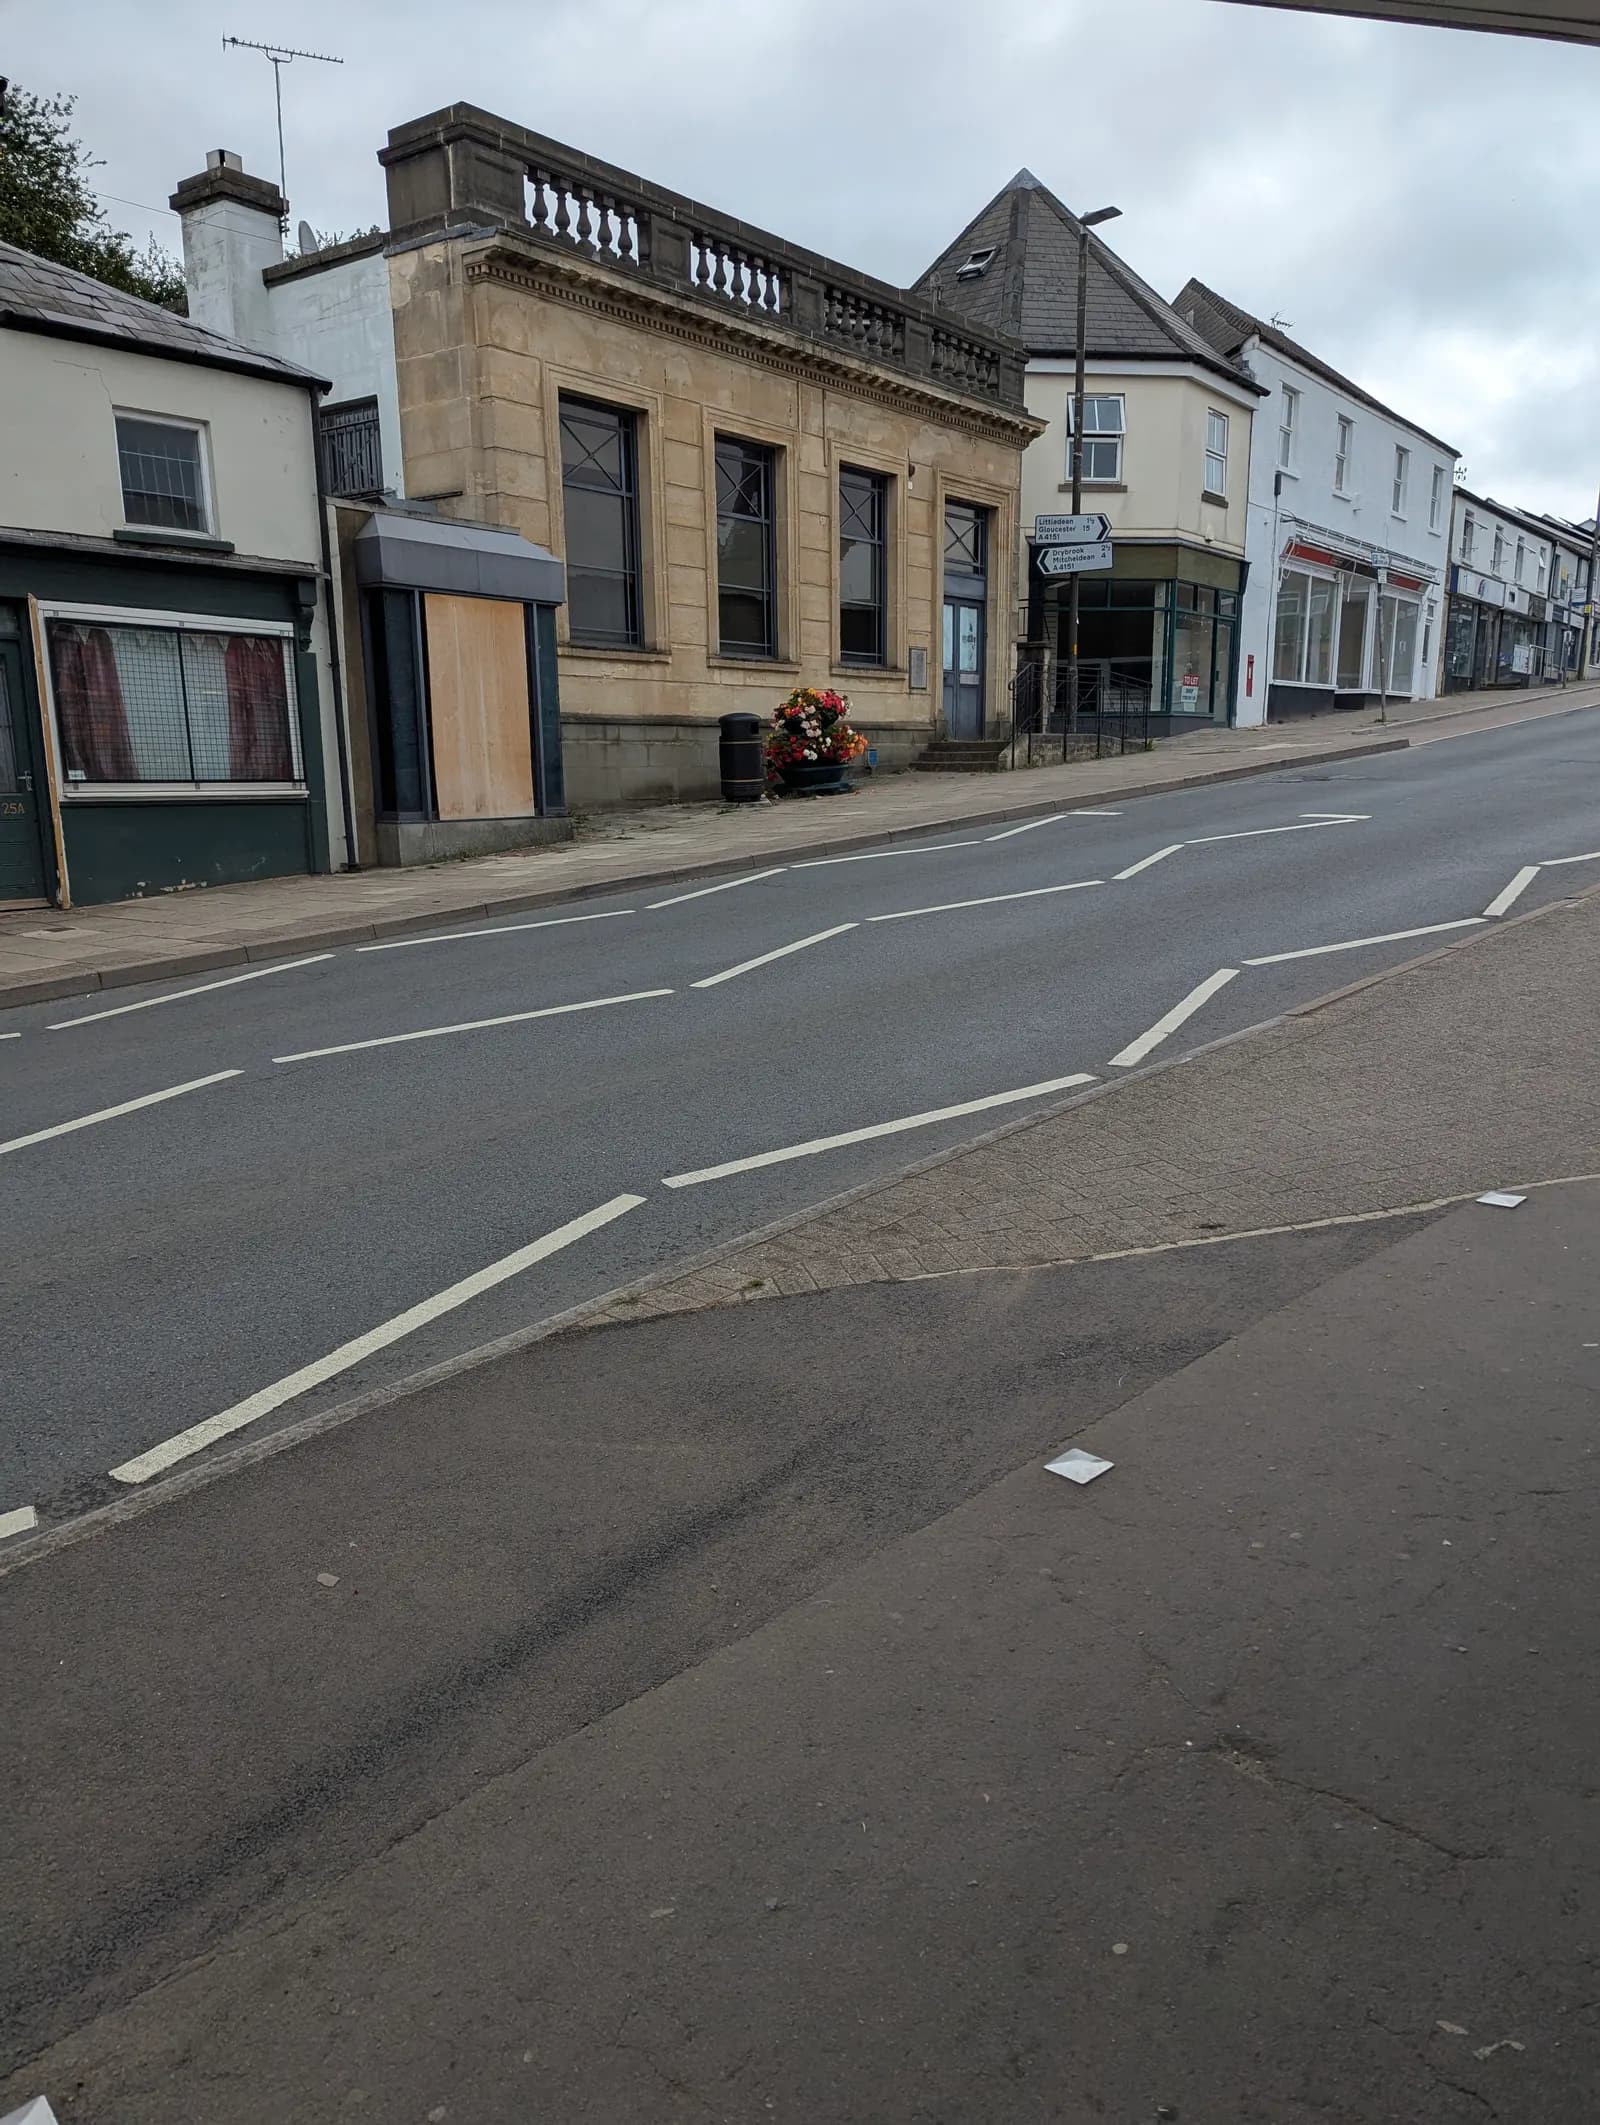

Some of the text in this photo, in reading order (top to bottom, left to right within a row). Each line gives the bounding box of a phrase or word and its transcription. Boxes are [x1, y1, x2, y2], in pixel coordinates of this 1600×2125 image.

[1052, 547, 1084, 556] Drybrook
[1052, 554, 1095, 563] Mitcheldean
[1, 802, 25, 814] 25A
